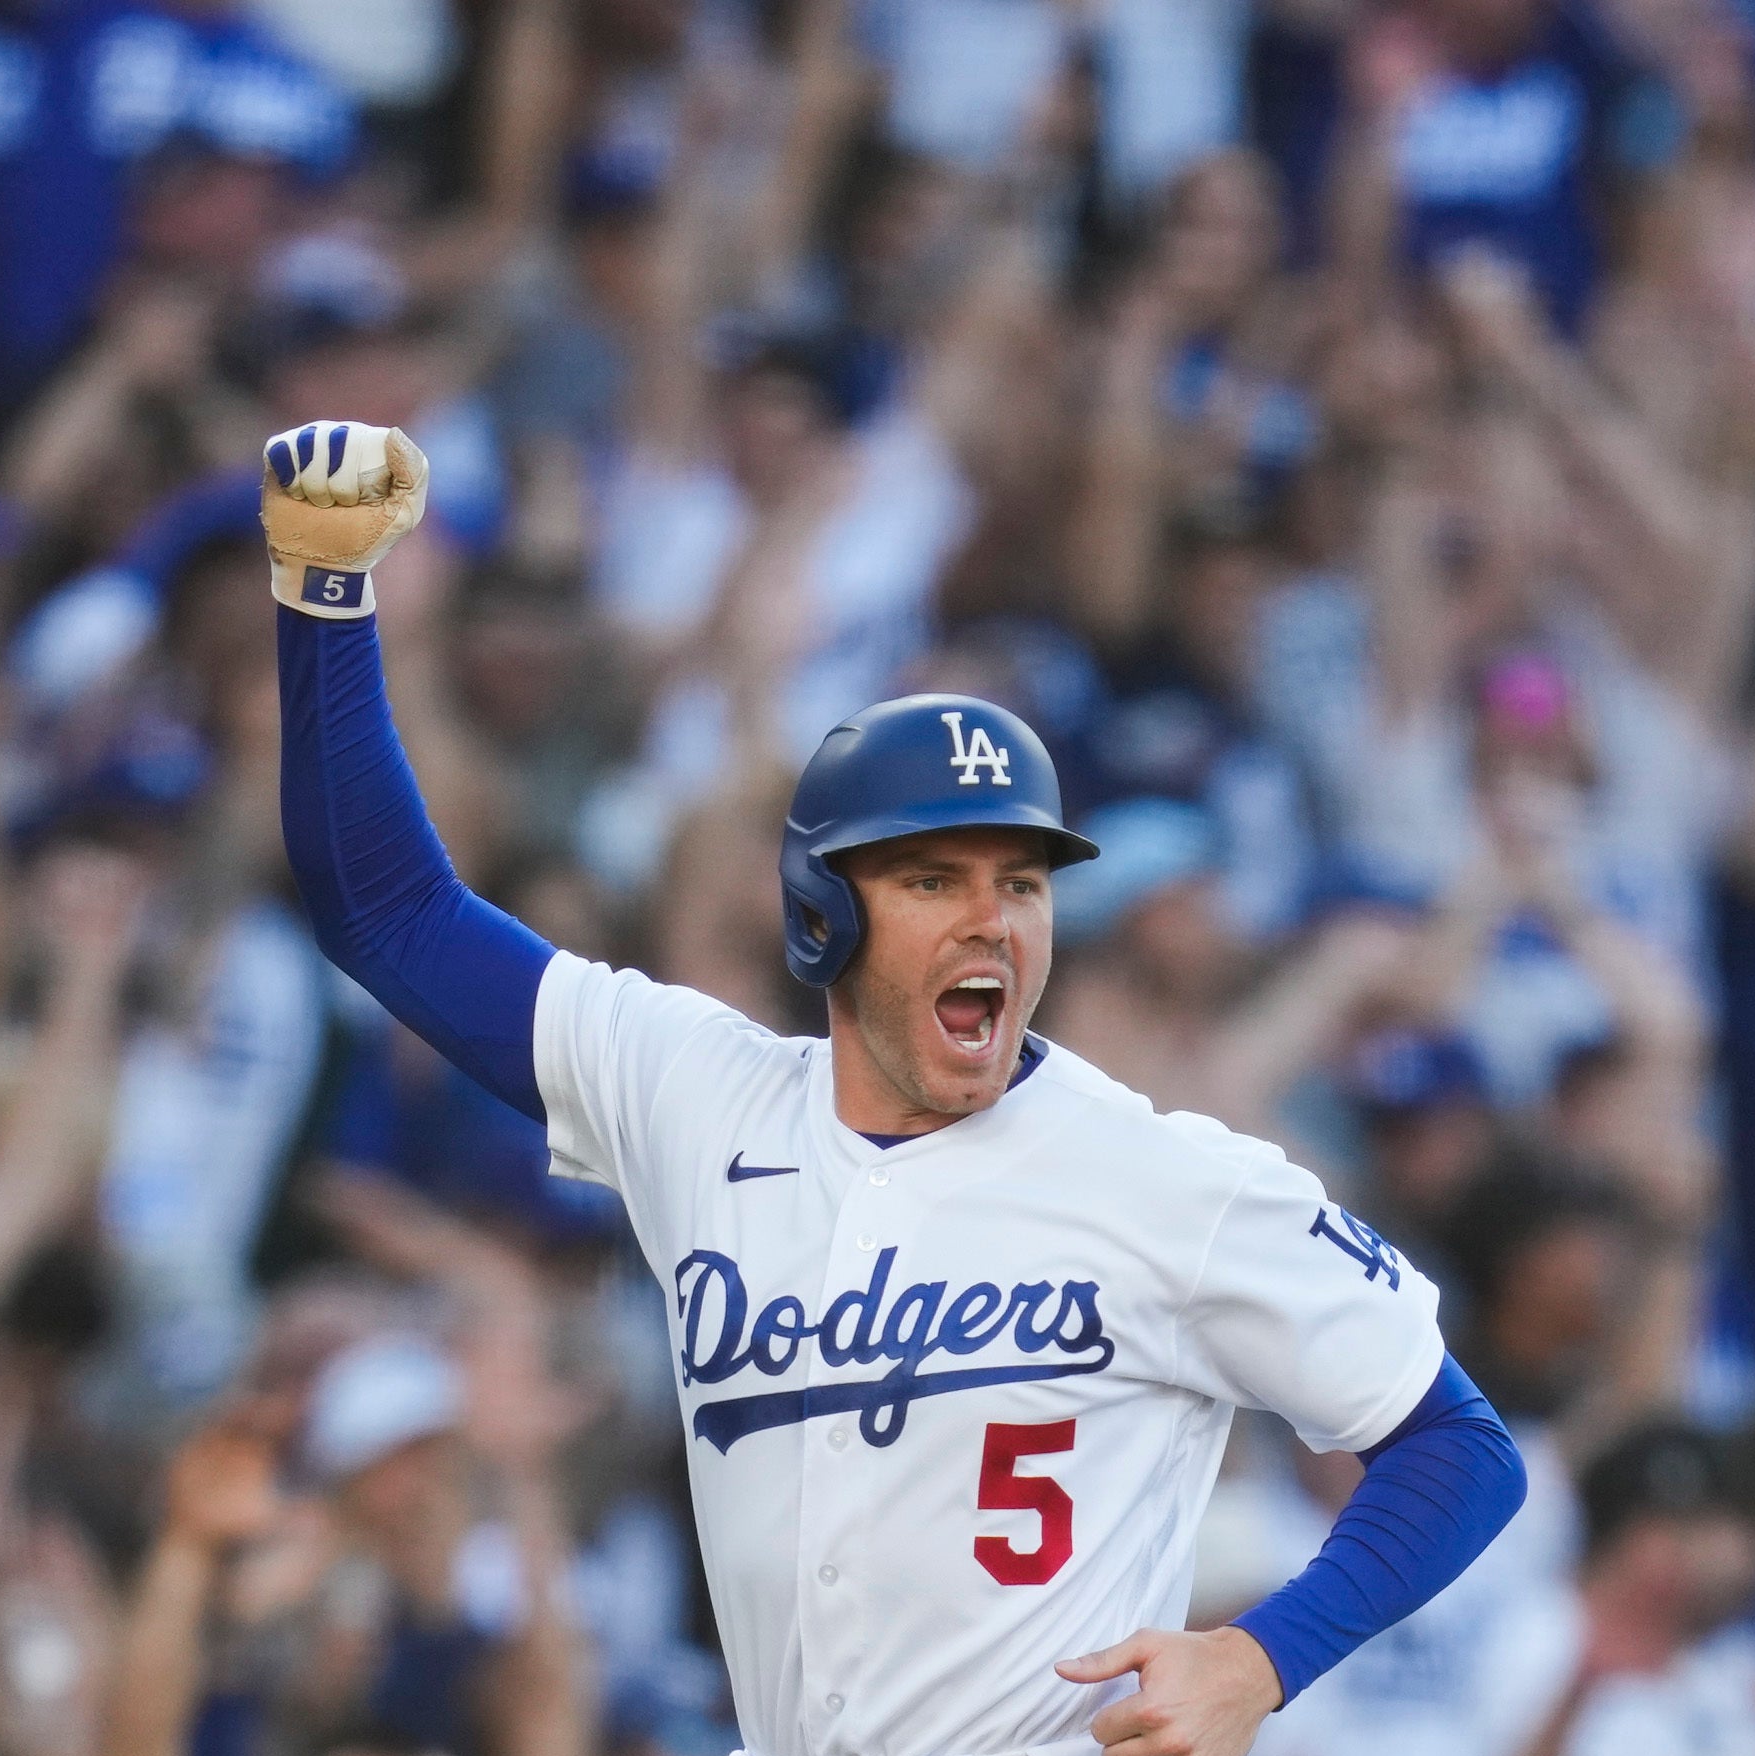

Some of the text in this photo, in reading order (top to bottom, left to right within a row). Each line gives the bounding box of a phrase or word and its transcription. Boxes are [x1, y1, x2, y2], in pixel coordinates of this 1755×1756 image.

[322, 574, 346, 602] 5
[940, 711, 1012, 786] LA
[1308, 1204, 1401, 1293] LA
[675, 1246, 1116, 1457] Dodgers
[974, 1419, 1076, 1587] 5
